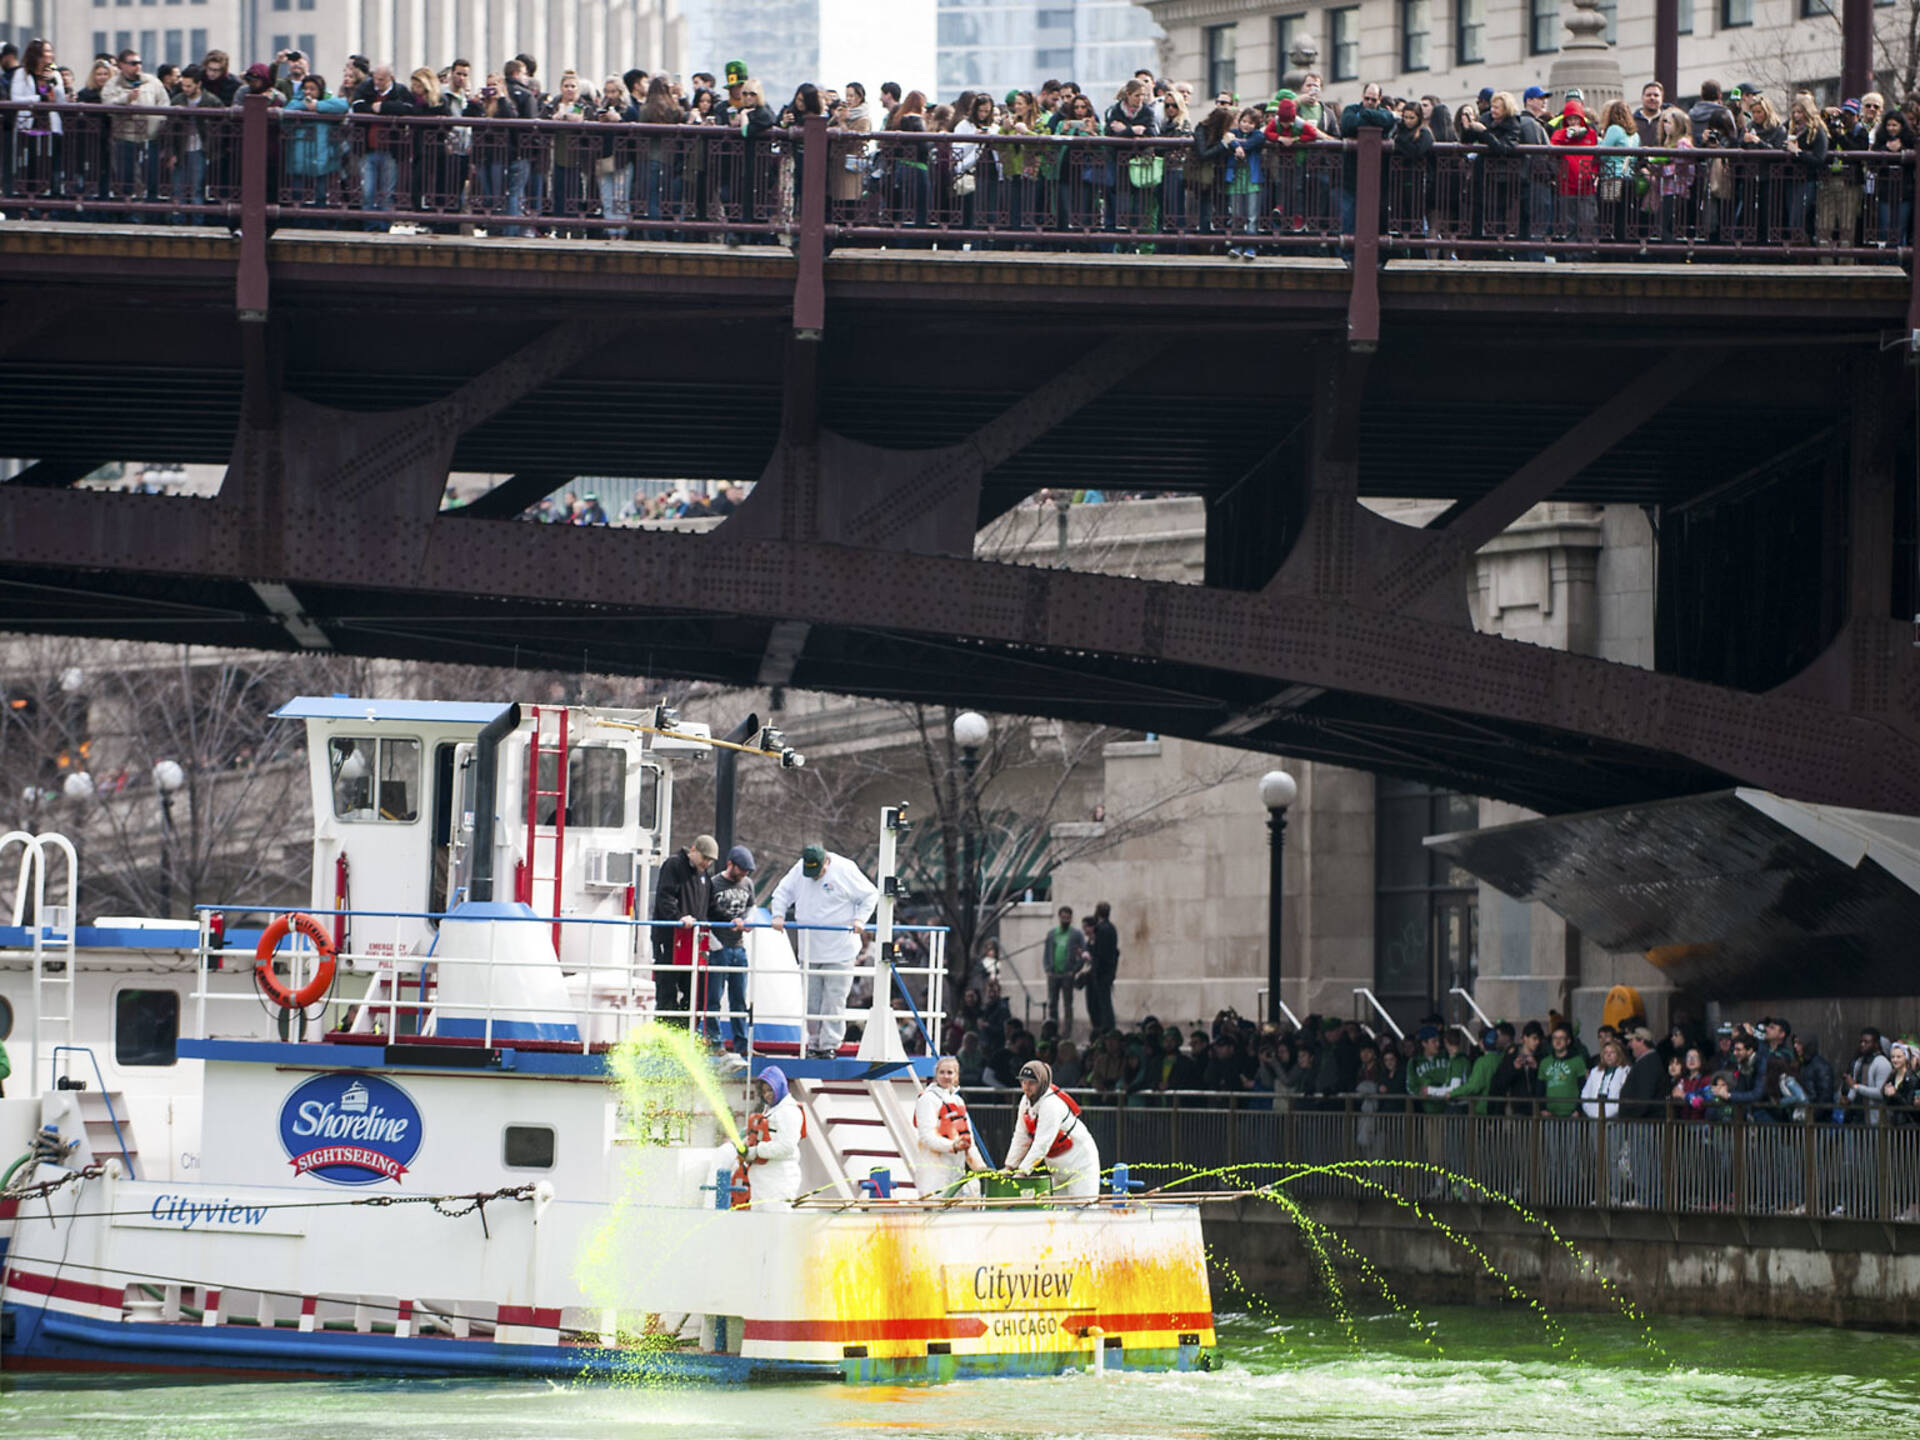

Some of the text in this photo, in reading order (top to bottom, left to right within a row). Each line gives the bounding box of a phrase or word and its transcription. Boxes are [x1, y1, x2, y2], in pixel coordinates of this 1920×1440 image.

[368, 943, 406, 951] EMERGECY
[292, 1100, 409, 1143] Shoreline
[297, 1147, 399, 1177] SIGHTSEEING
[151, 1194, 269, 1231] Cityview
[974, 1264, 1073, 1310] Cityview
[993, 1317, 1057, 1337] CHICAGO
